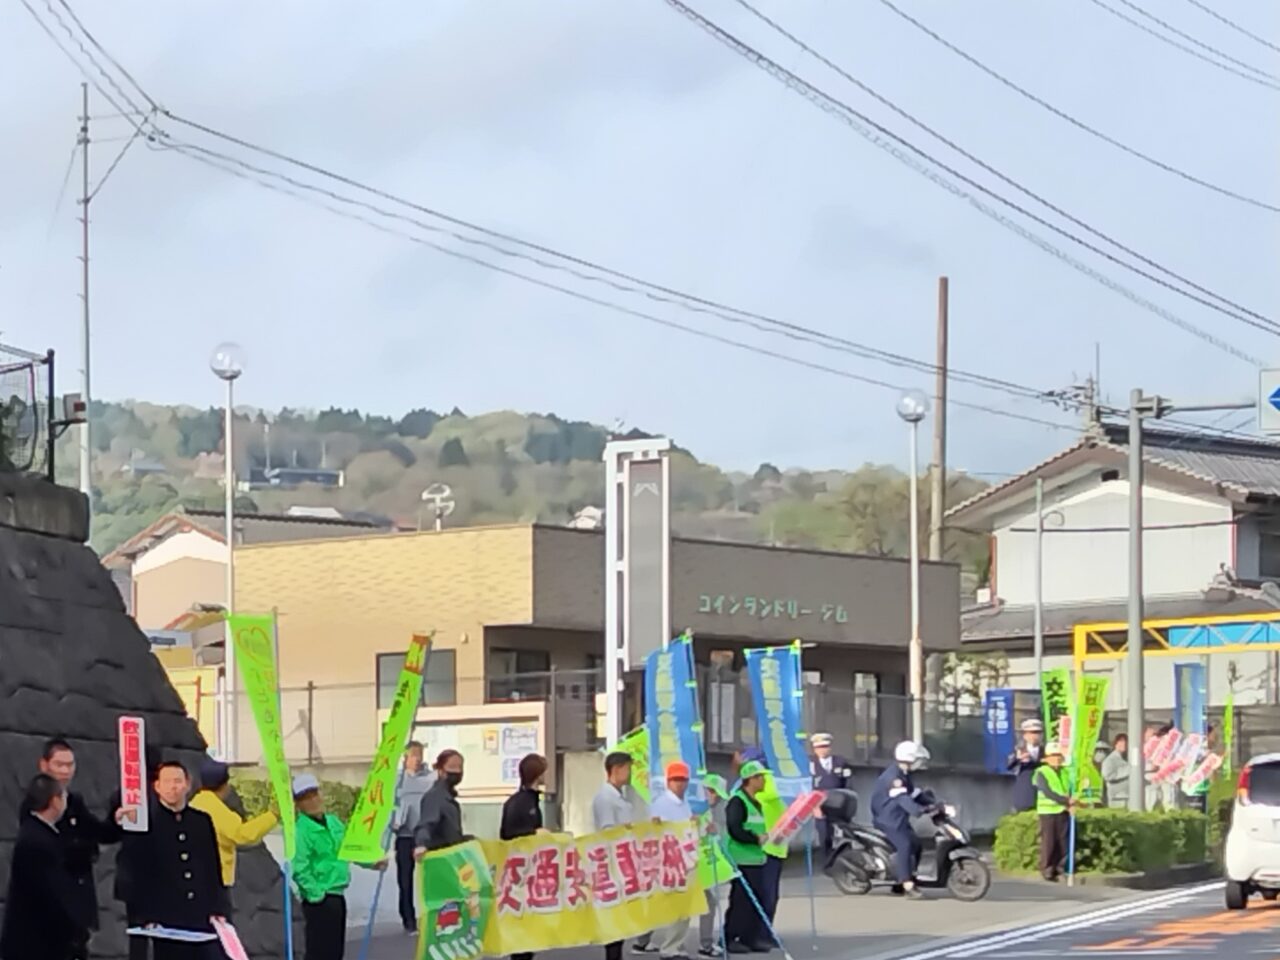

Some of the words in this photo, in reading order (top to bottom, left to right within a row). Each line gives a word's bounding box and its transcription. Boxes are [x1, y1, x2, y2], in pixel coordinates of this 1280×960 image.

[699, 595, 812, 619] コインランドリー
